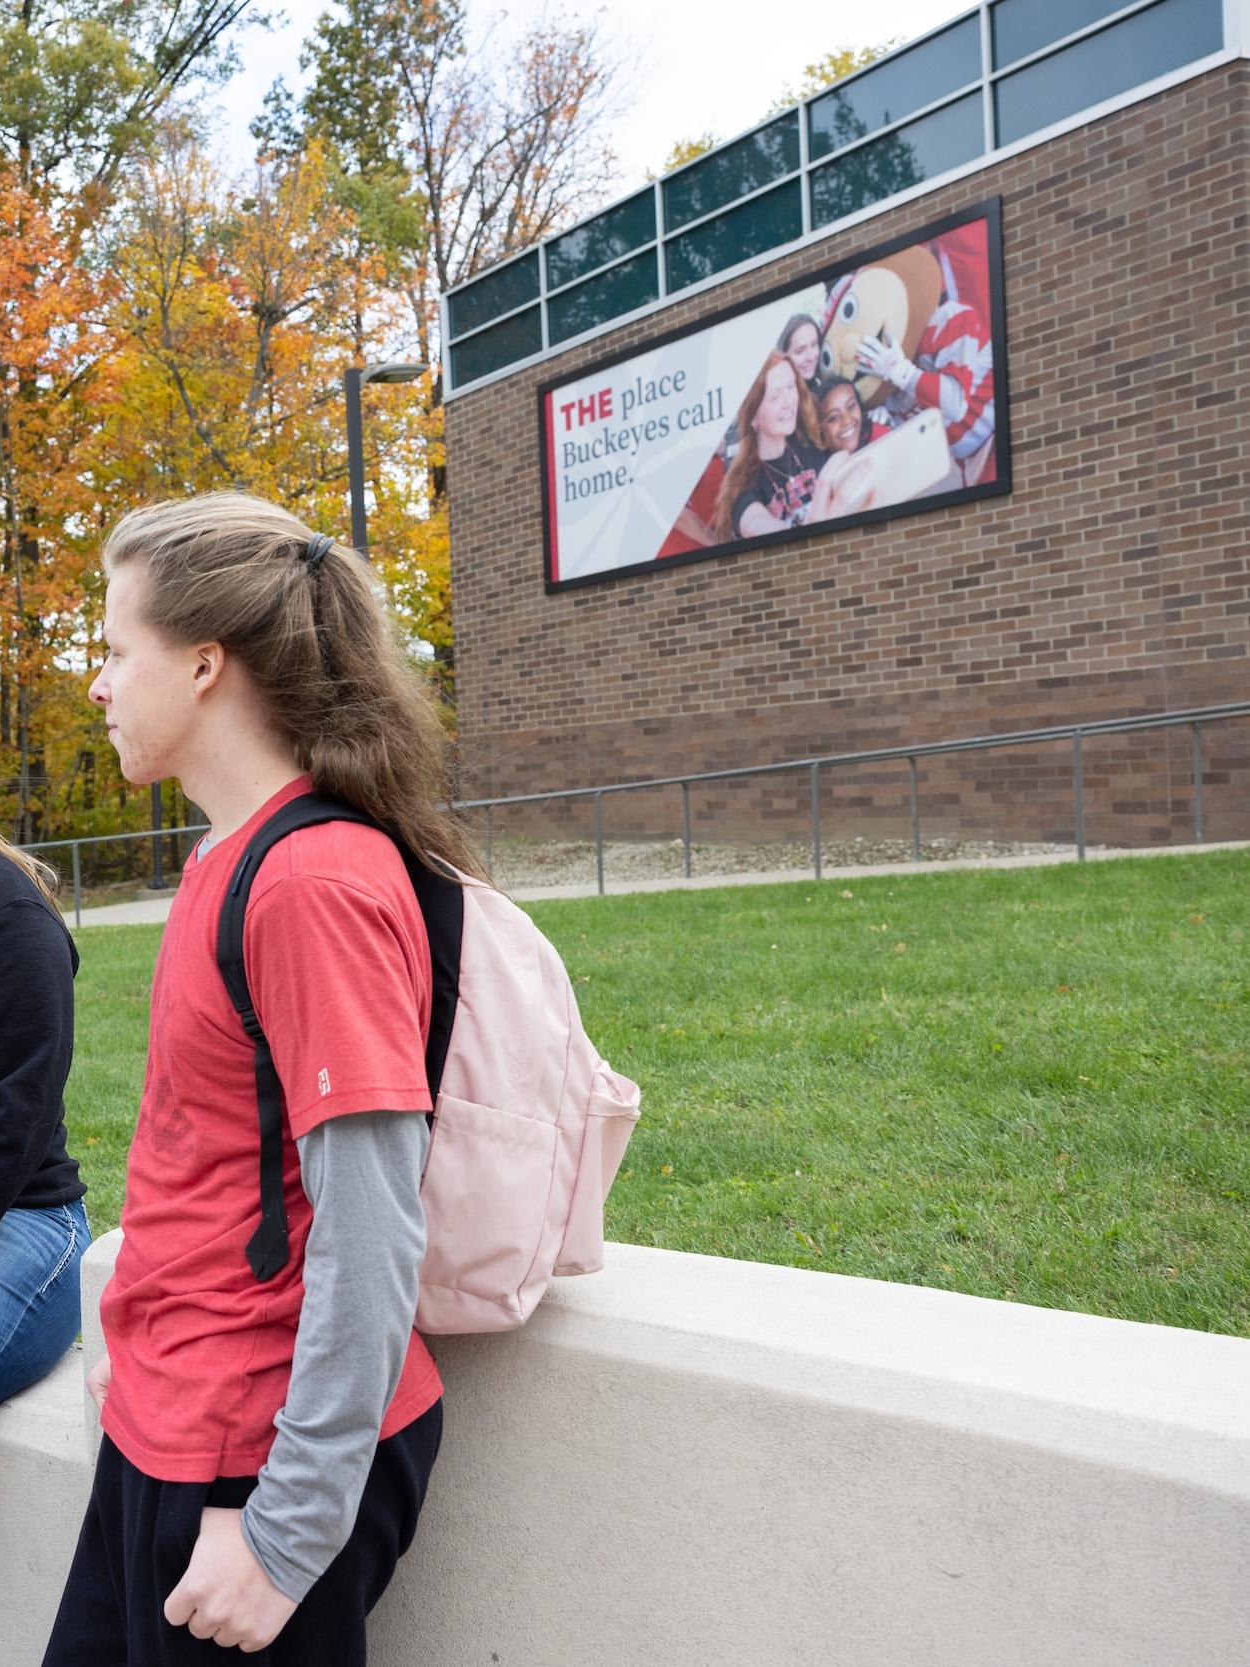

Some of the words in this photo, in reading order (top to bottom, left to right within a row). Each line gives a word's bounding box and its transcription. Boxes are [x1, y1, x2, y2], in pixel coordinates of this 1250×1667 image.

[560, 387, 613, 432] THE
[621, 369, 687, 420] place
[562, 412, 670, 470] Buckeyes
[677, 387, 724, 431] call
[563, 465, 635, 503] home.
